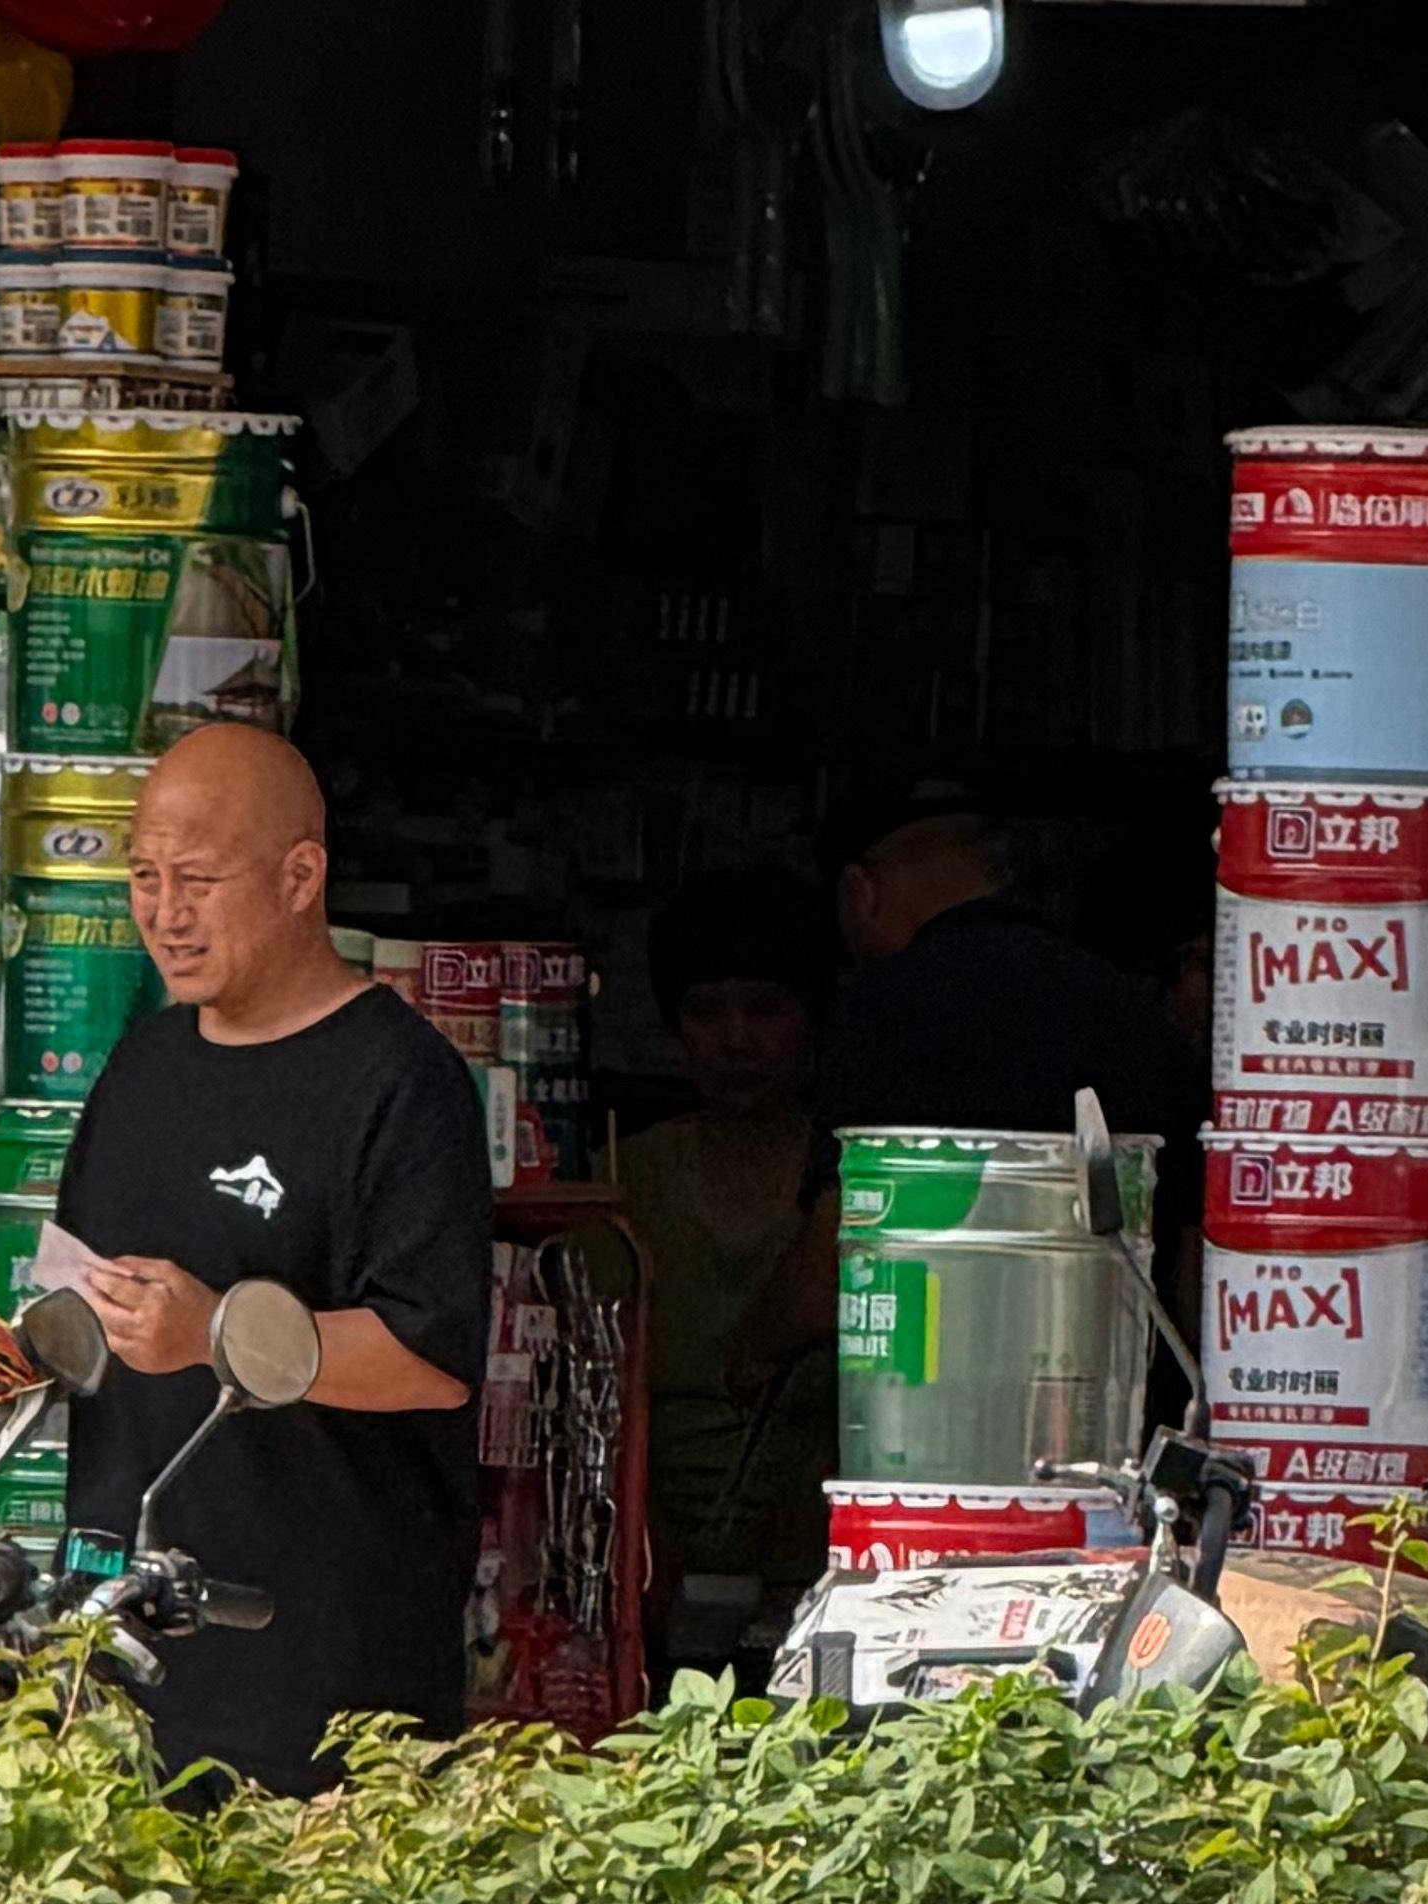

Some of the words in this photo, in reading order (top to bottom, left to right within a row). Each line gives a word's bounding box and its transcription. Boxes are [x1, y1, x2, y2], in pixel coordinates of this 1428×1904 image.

[1317, 814, 1400, 854] 立邦
[1295, 915, 1349, 934] PRO
[1275, 1161, 1354, 1201] 立邦
[1255, 1264, 1303, 1281] PRO
[1267, 1512, 1346, 1551] 立邦
